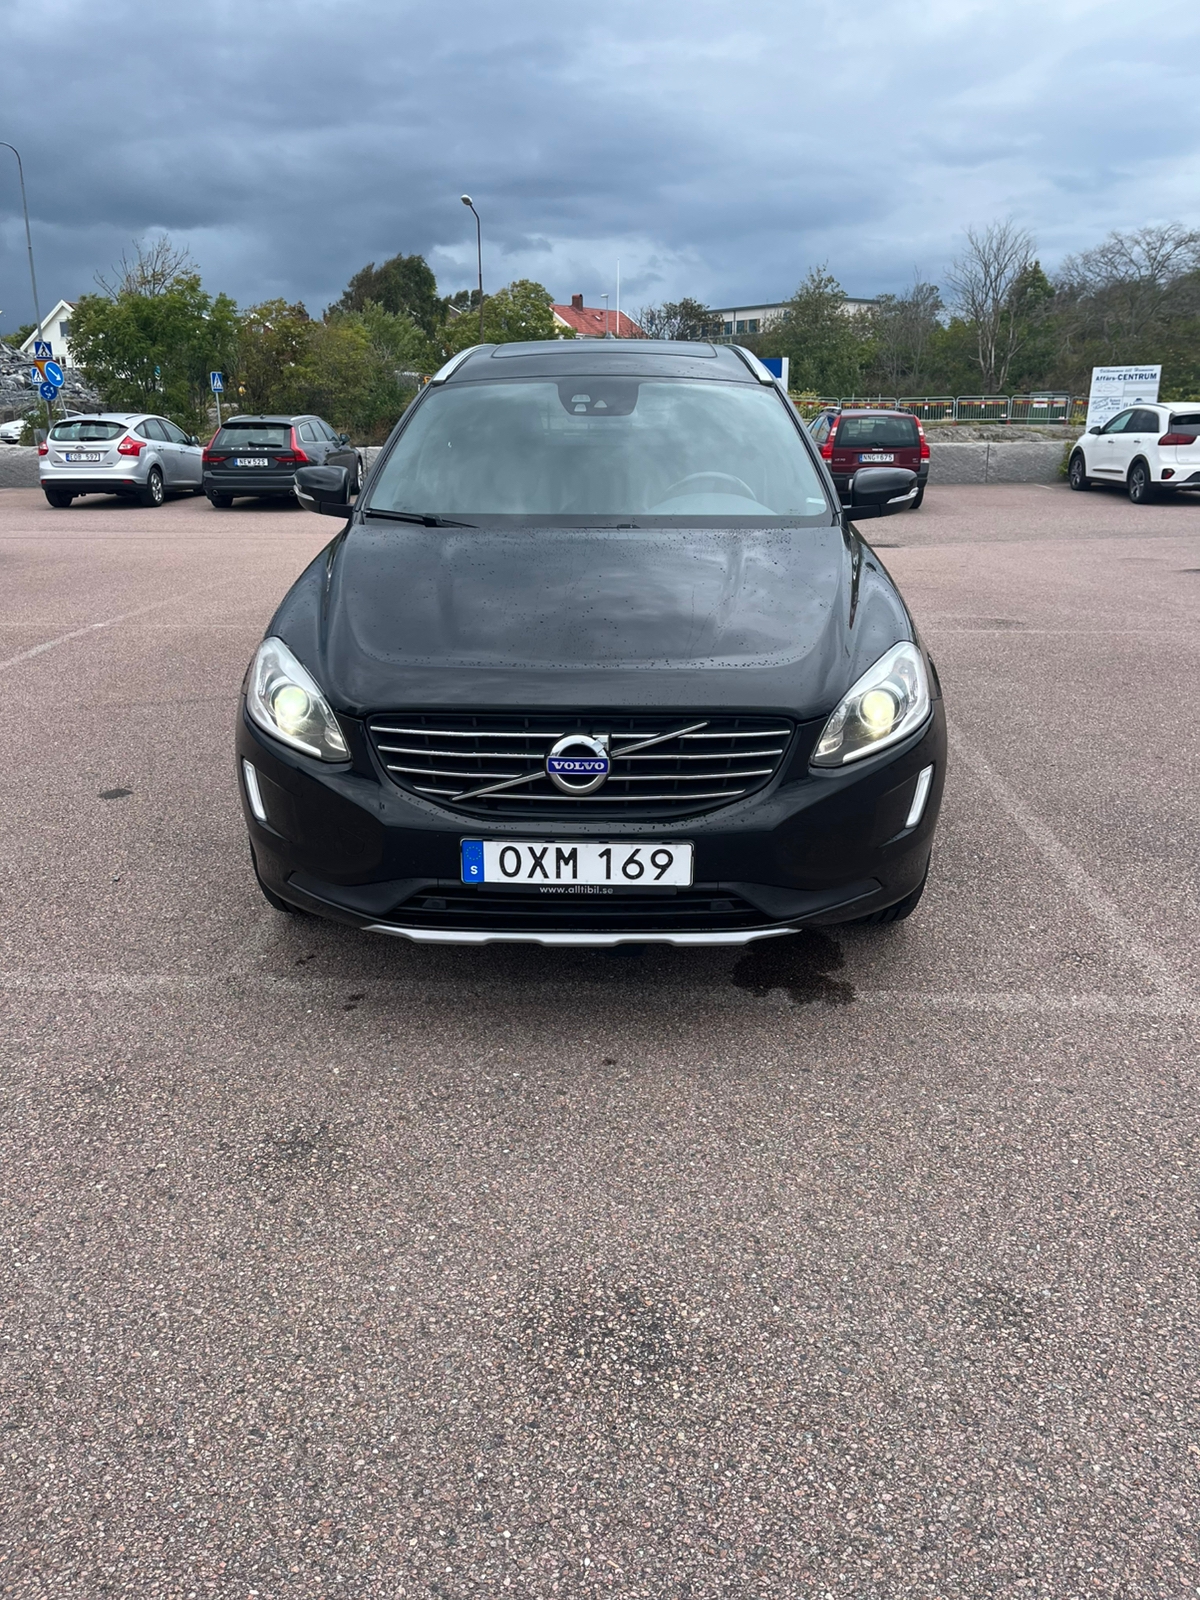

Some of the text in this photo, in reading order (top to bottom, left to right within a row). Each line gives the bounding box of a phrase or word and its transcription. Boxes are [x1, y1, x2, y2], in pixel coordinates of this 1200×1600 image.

[551, 761, 605, 770] VOLVO
[498, 846, 674, 881] OXM 169
[470, 865, 478, 875] S
[539, 885, 614, 895] www.alltibil.se
